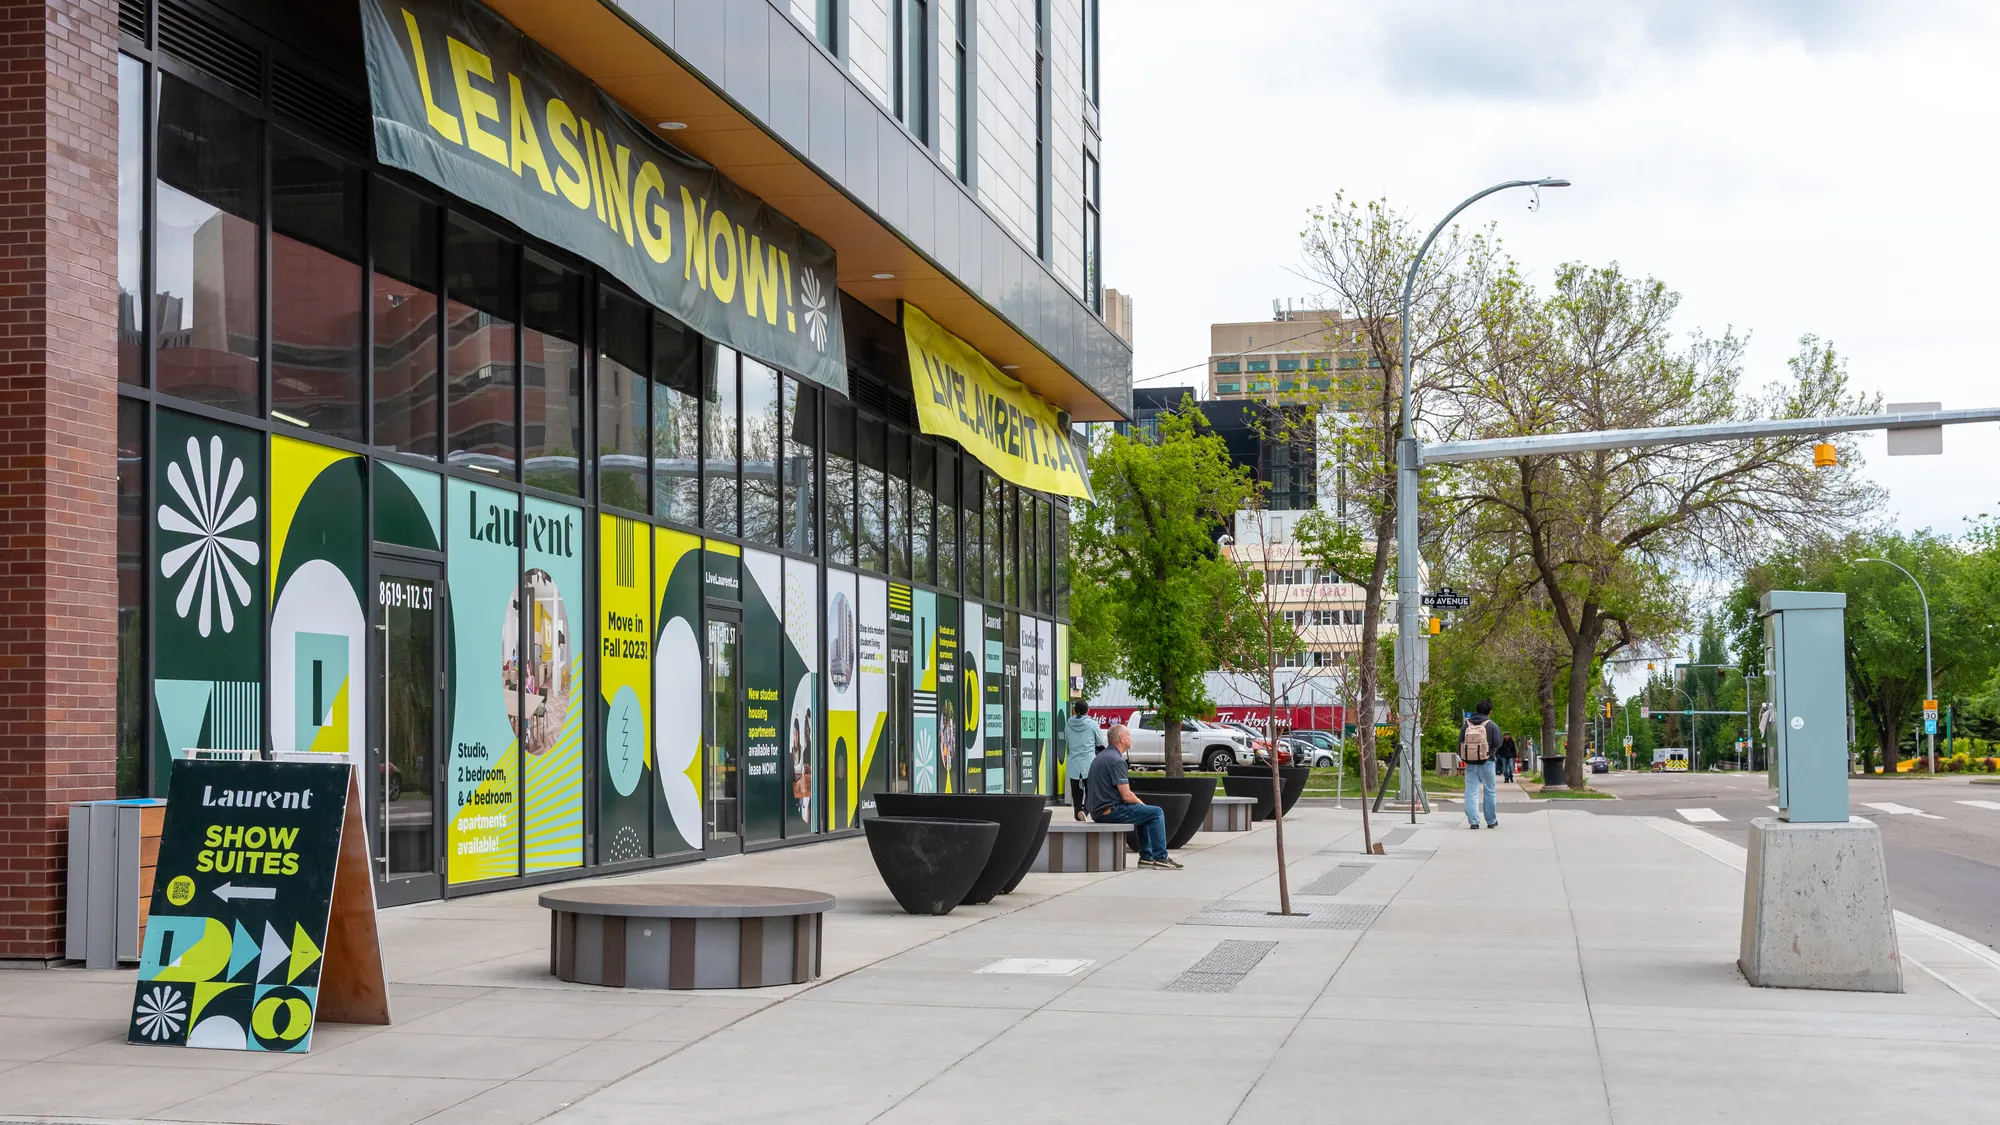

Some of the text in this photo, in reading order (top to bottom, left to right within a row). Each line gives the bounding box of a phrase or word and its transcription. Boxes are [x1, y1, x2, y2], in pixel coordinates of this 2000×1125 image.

[401, 7, 796, 334] LEASING NOW!
[470, 490, 573, 558] Laurent
[705, 572, 739, 588] LiveLaurent.ca
[380, 580, 432, 610] 8619-112 ST
[608, 611, 644, 633] Move in
[984, 613, 1002, 630] Laurent
[730, 628, 736, 644] ST
[1022, 630, 1044, 650] Excluve
[604, 638, 648, 660] Fall 2023!
[748, 688, 778, 700] New student
[748, 706, 768, 721] housing
[748, 726, 776, 740] apartments
[458, 742, 488, 760] Studio,
[748, 744, 770, 756] available
[458, 766, 506, 784] 2 bedroom,
[748, 762, 777, 776] lease NOW!
[202, 786, 314, 810] Laurent
[458, 790, 512, 806] & 4 bedroom
[458, 813, 507, 834] apartments
[204, 825, 300, 850] SHOW
[458, 836, 499, 855] available!
[196, 850, 300, 876] SUITES
